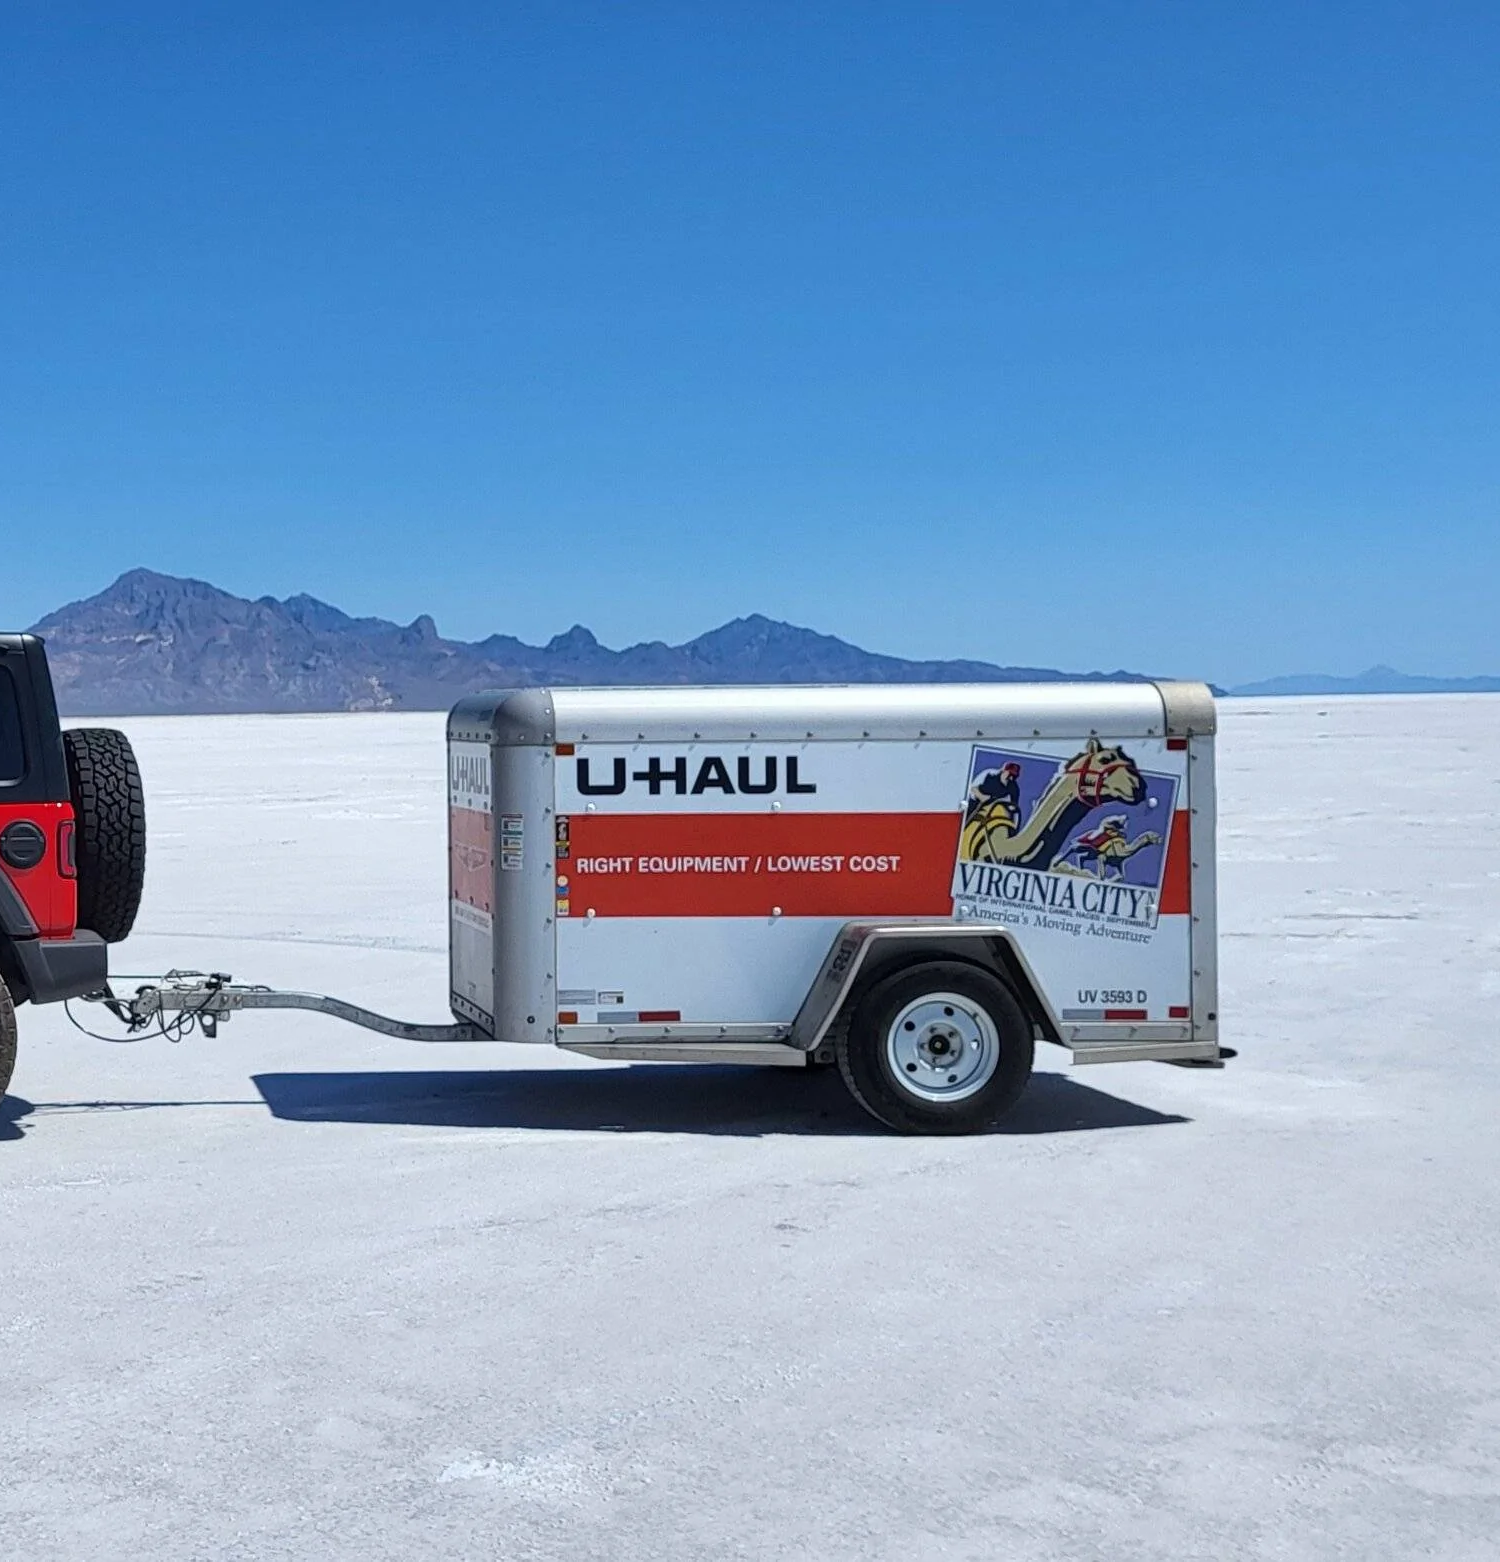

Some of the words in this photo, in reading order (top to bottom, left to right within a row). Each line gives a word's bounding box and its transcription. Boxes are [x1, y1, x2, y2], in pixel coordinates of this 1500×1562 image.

[576, 856, 633, 874] RIGHT
[638, 856, 750, 874] EQUIPMENT
[767, 855, 845, 873] LOWEST
[849, 855, 901, 873] COST
[959, 862, 1076, 910] VIRGINIA
[1082, 881, 1147, 919] CITY
[967, 904, 1029, 925] America's
[1033, 914, 1082, 937] Moving
[1085, 922, 1153, 945] Adventure
[1106, 915, 1151, 929] SEPTEMBER
[1078, 989, 1099, 1004] UV
[1100, 989, 1133, 1004] 3593
[1137, 989, 1148, 1004] D
